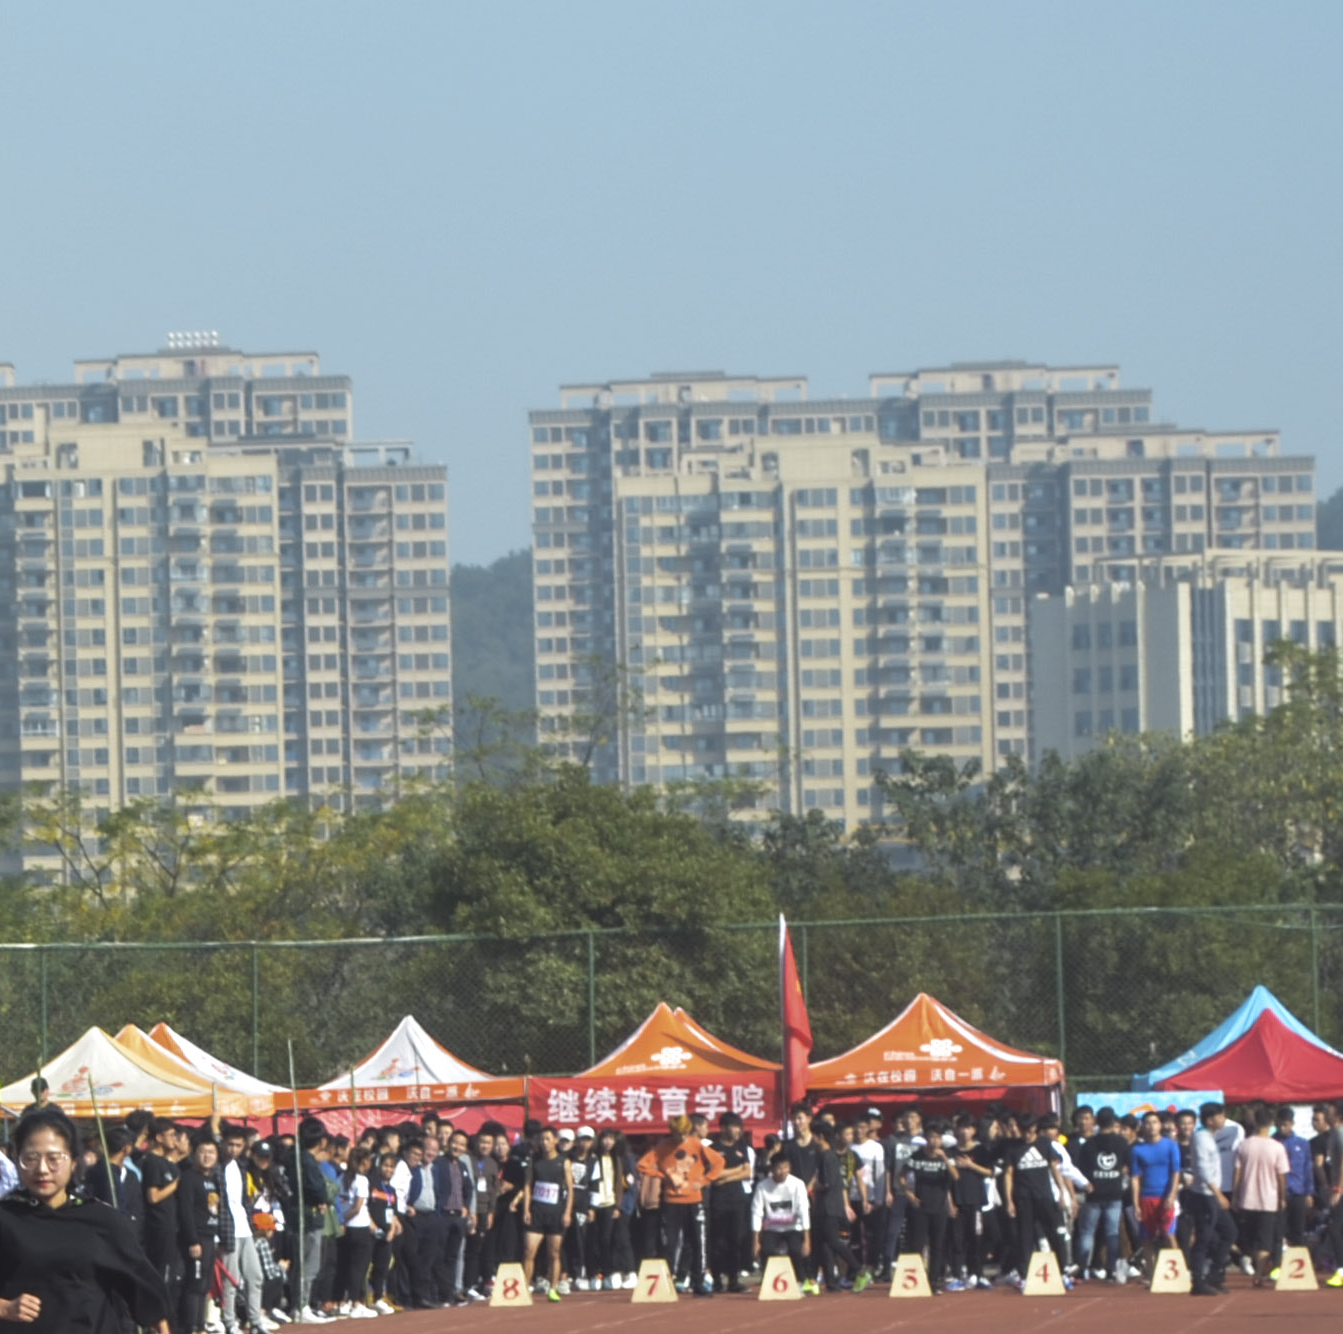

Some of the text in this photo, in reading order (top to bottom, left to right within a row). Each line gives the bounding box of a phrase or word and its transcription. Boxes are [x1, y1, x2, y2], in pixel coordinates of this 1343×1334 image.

[547, 1084, 765, 1123] 继续教育学院
[901, 1268, 918, 1290] 5
[1035, 1263, 1050, 1283] 4
[1164, 1259, 1179, 1280] 3
[1288, 1259, 1305, 1279] 2
[503, 1278, 519, 1300] 8
[646, 1274, 660, 1296] 7
[772, 1271, 789, 1293] 6
